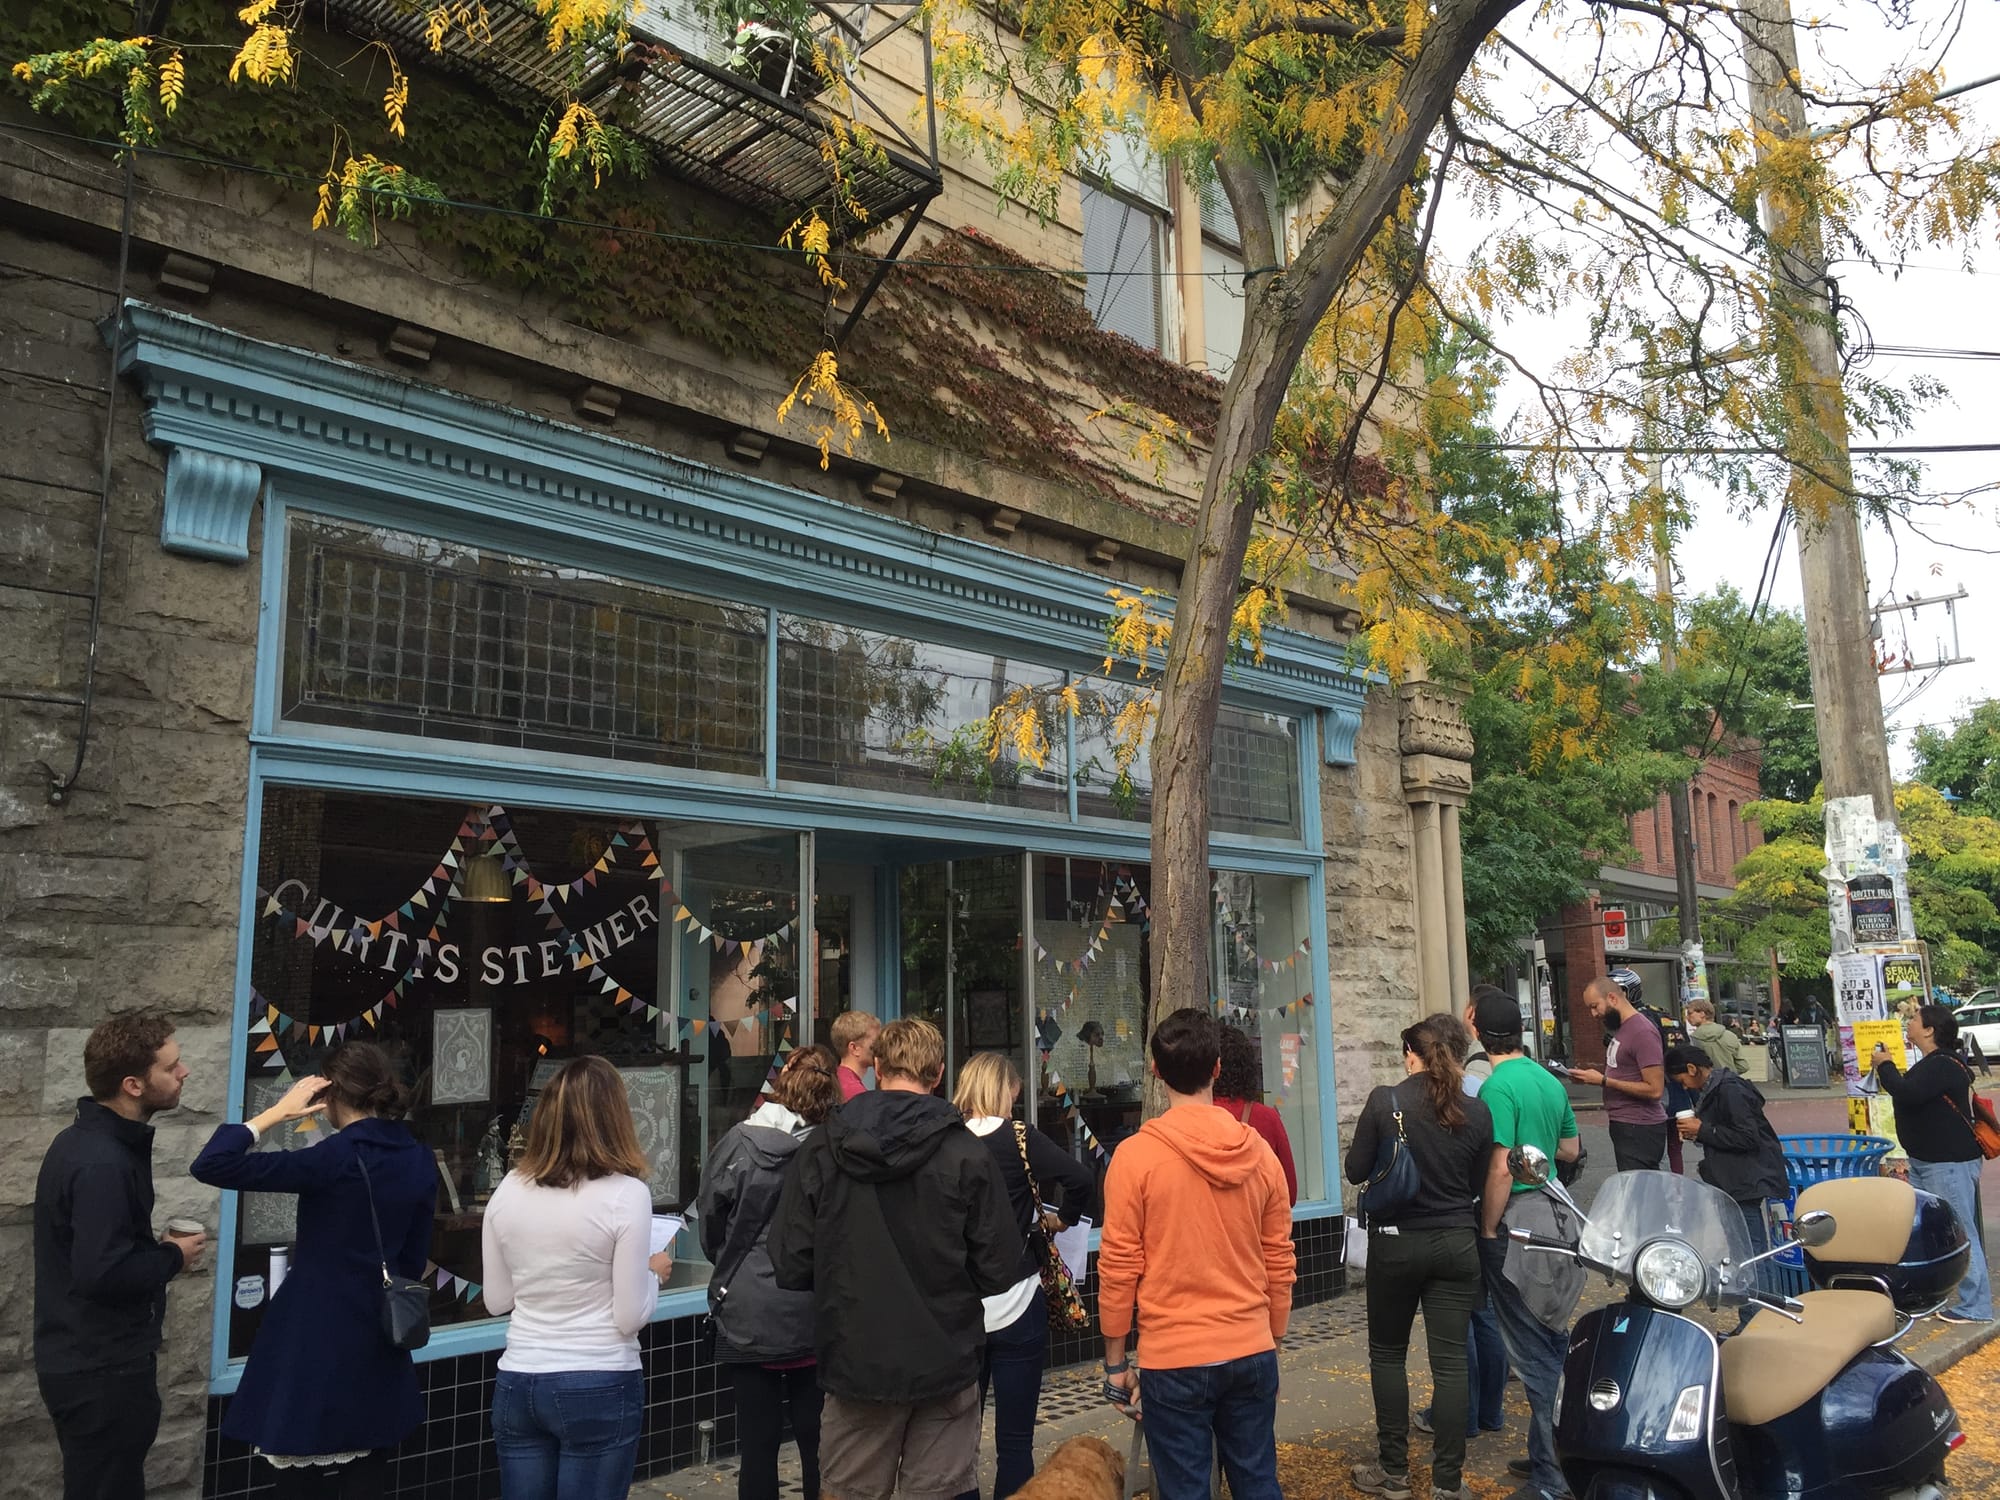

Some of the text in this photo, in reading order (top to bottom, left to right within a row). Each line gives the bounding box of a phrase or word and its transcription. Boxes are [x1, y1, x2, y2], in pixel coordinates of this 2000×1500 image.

[1859, 916, 1891, 924] SURFACE
[272, 878, 660, 986] CURTIS STEINER
[1885, 966, 1920, 976] SERIAL
[1886, 974, 1920, 984] HAWK
[1841, 1000, 1874, 1011] TION
